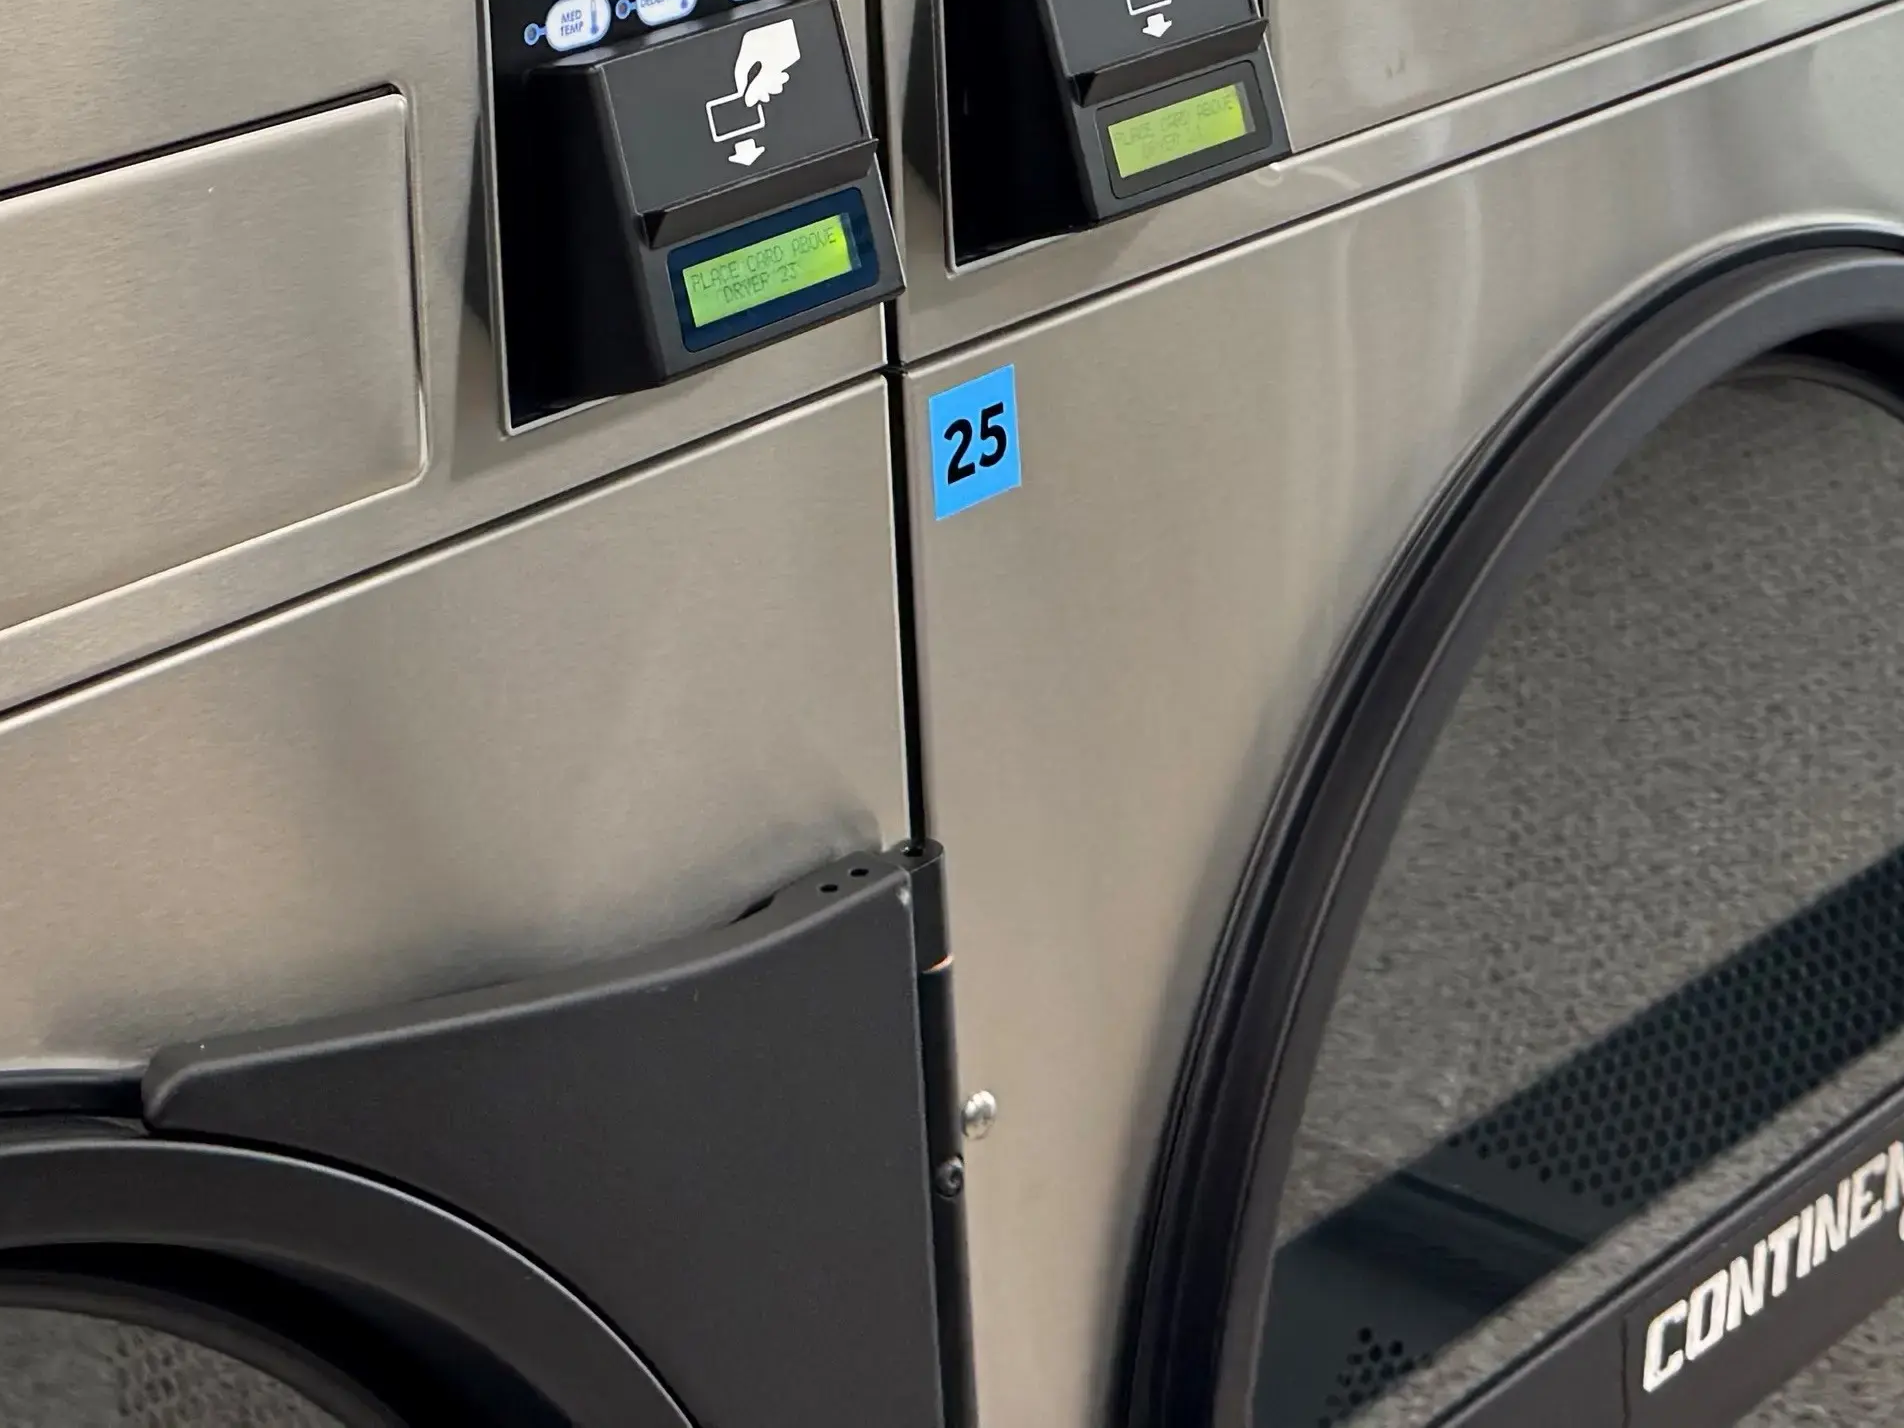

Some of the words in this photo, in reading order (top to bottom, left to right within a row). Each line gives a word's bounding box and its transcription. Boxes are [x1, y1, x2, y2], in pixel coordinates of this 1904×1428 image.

[560, 21, 584, 37] TEMP
[561, 7, 582, 23] MED
[689, 259, 741, 293] PLACE
[746, 244, 784, 273] CARD
[791, 226, 837, 257] ABOVE
[944, 401, 1007, 485] 25
